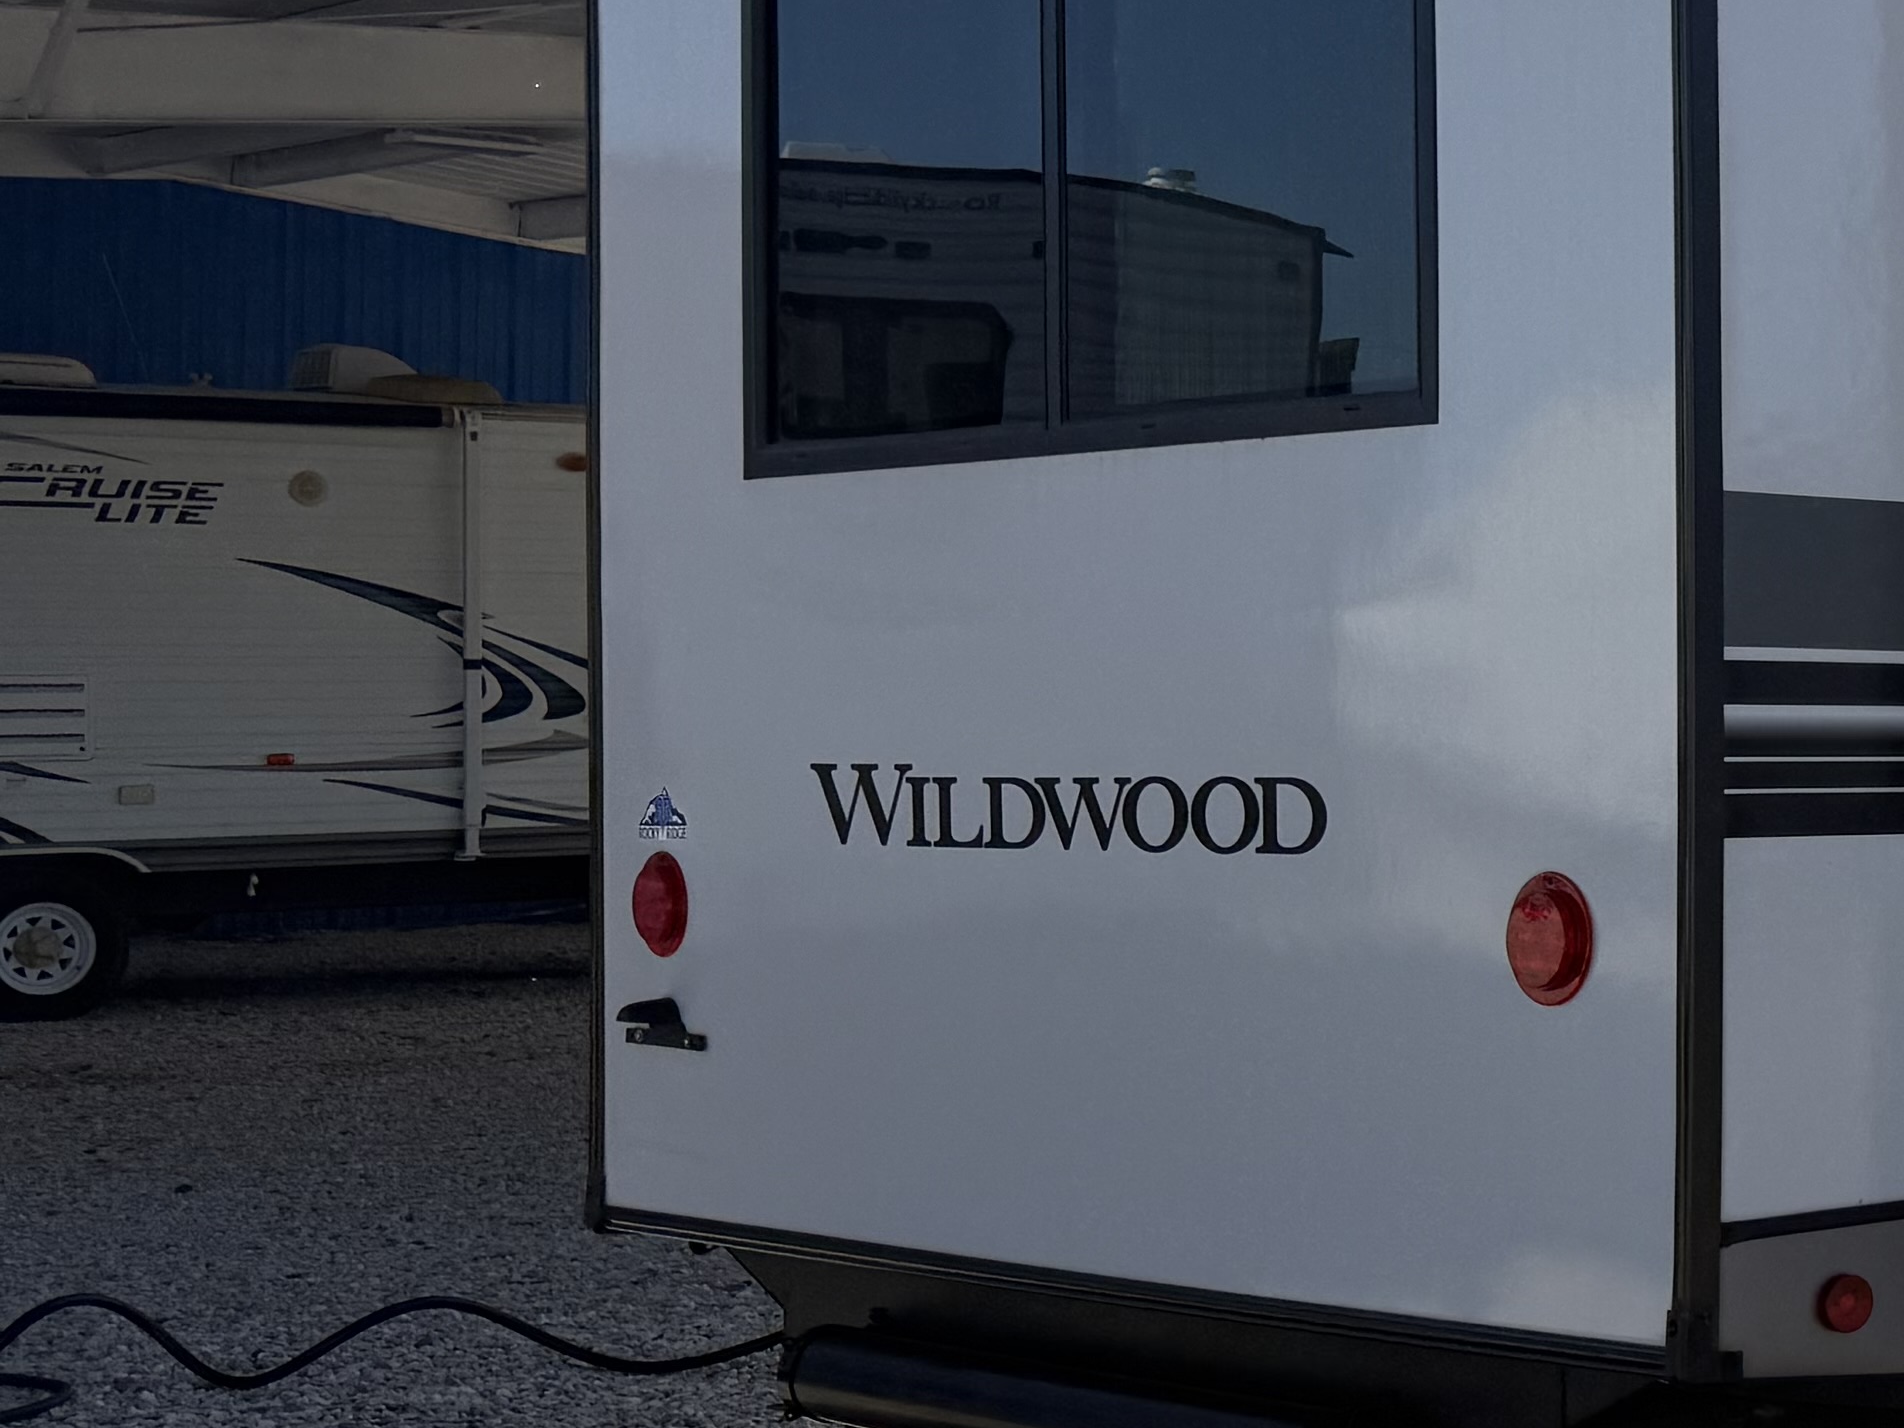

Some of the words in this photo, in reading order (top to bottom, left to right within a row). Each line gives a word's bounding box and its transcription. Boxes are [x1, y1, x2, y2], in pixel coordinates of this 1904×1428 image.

[5, 462, 104, 474] SALEM
[95, 502, 214, 525] LITE
[810, 763, 1328, 855] WILDWOOD
